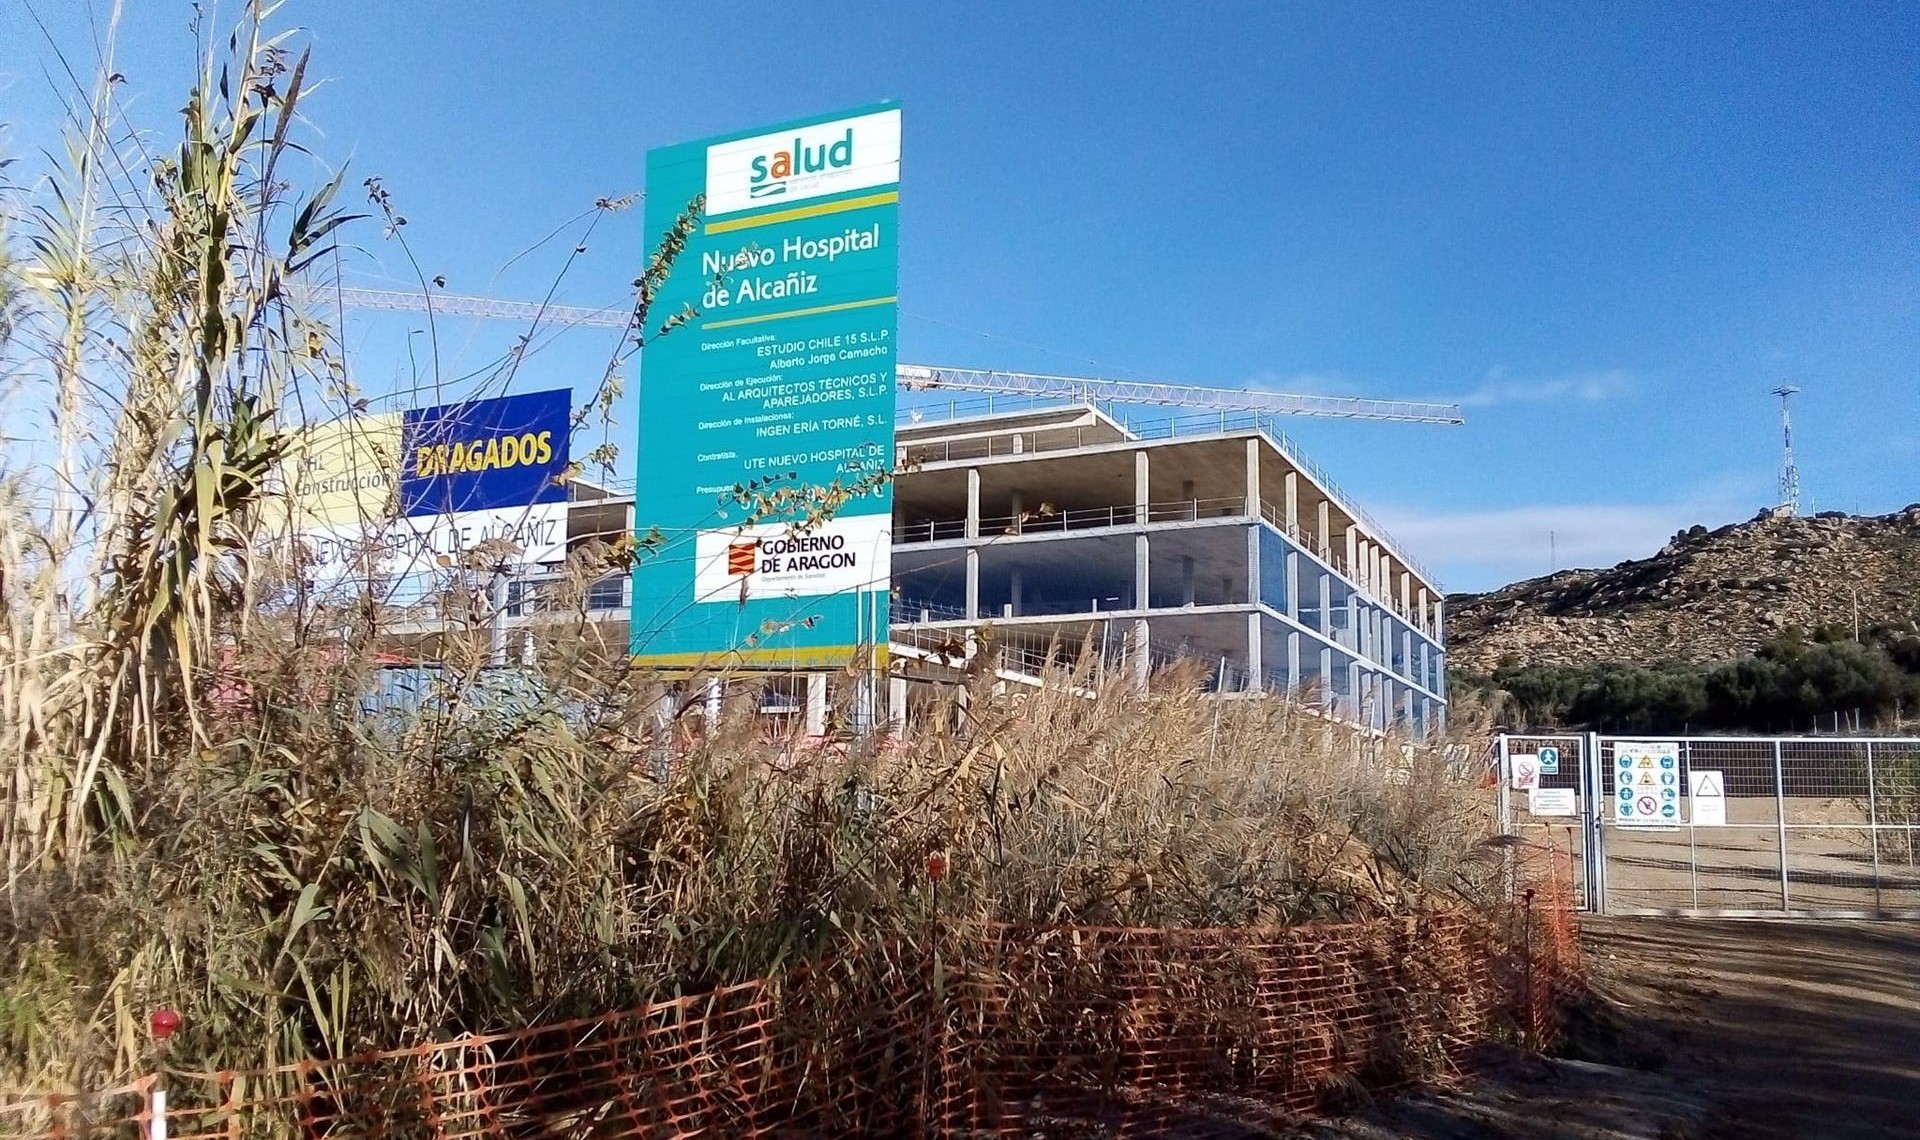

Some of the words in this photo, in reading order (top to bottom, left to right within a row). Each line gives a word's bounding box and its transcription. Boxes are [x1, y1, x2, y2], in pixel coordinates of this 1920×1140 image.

[750, 128, 853, 183] salud
[703, 247, 776, 276] Nuevo
[783, 223, 879, 263] Hospital
[703, 282, 730, 309] de
[736, 272, 818, 304] Alcañiz
[701, 340, 734, 351] Dirección
[757, 342, 805, 357] ESTUDIO
[808, 335, 841, 350] CHILE
[844, 333, 857, 345] 15
[769, 356, 805, 370] Alberto
[808, 352, 836, 365] Jorge
[839, 344, 888, 360] Camacho
[700, 380, 733, 391] Dirección
[734, 379, 745, 387] de
[722, 391, 735, 402] AL
[737, 380, 816, 401] ARQUITECTOS
[818, 373, 877, 389] TÉCNICOS
[880, 371, 888, 383] Y
[698, 419, 732, 430] Dirección
[733, 418, 743, 426] de
[867, 414, 887, 426] S.L.
[416, 430, 552, 477] DRAGADOS
[743, 459, 766, 470] UTE
[768, 453, 808, 467] NUEVO
[810, 447, 865, 463] HOSPITAL
[868, 445, 885, 457] DE
[761, 534, 845, 556] GOBIERNO
[761, 559, 781, 574] DE
[786, 552, 857, 573] ARAGON
